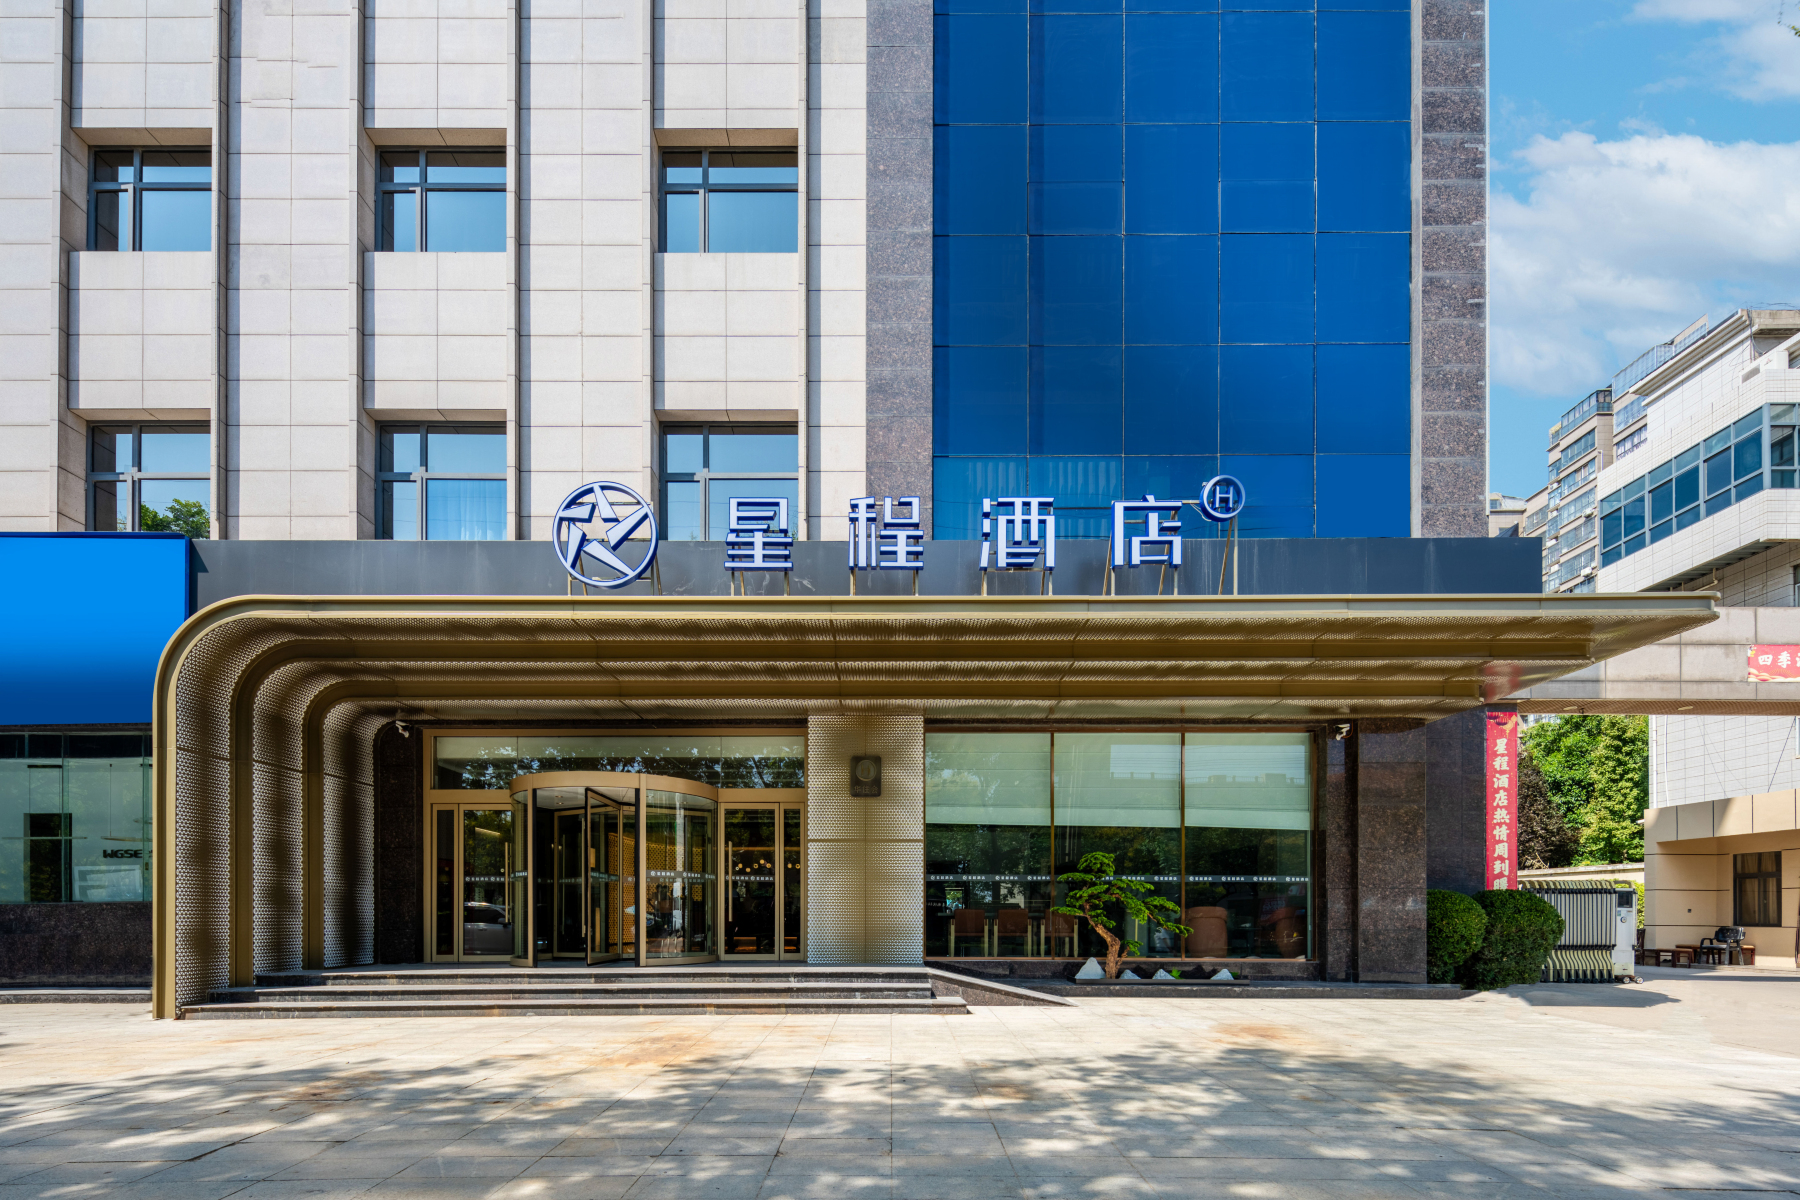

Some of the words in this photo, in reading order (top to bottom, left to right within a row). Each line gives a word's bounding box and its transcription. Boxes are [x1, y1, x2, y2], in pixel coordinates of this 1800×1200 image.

[724, 495, 1183, 570] 星程酒店
[102, 849, 152, 858] WGSE
